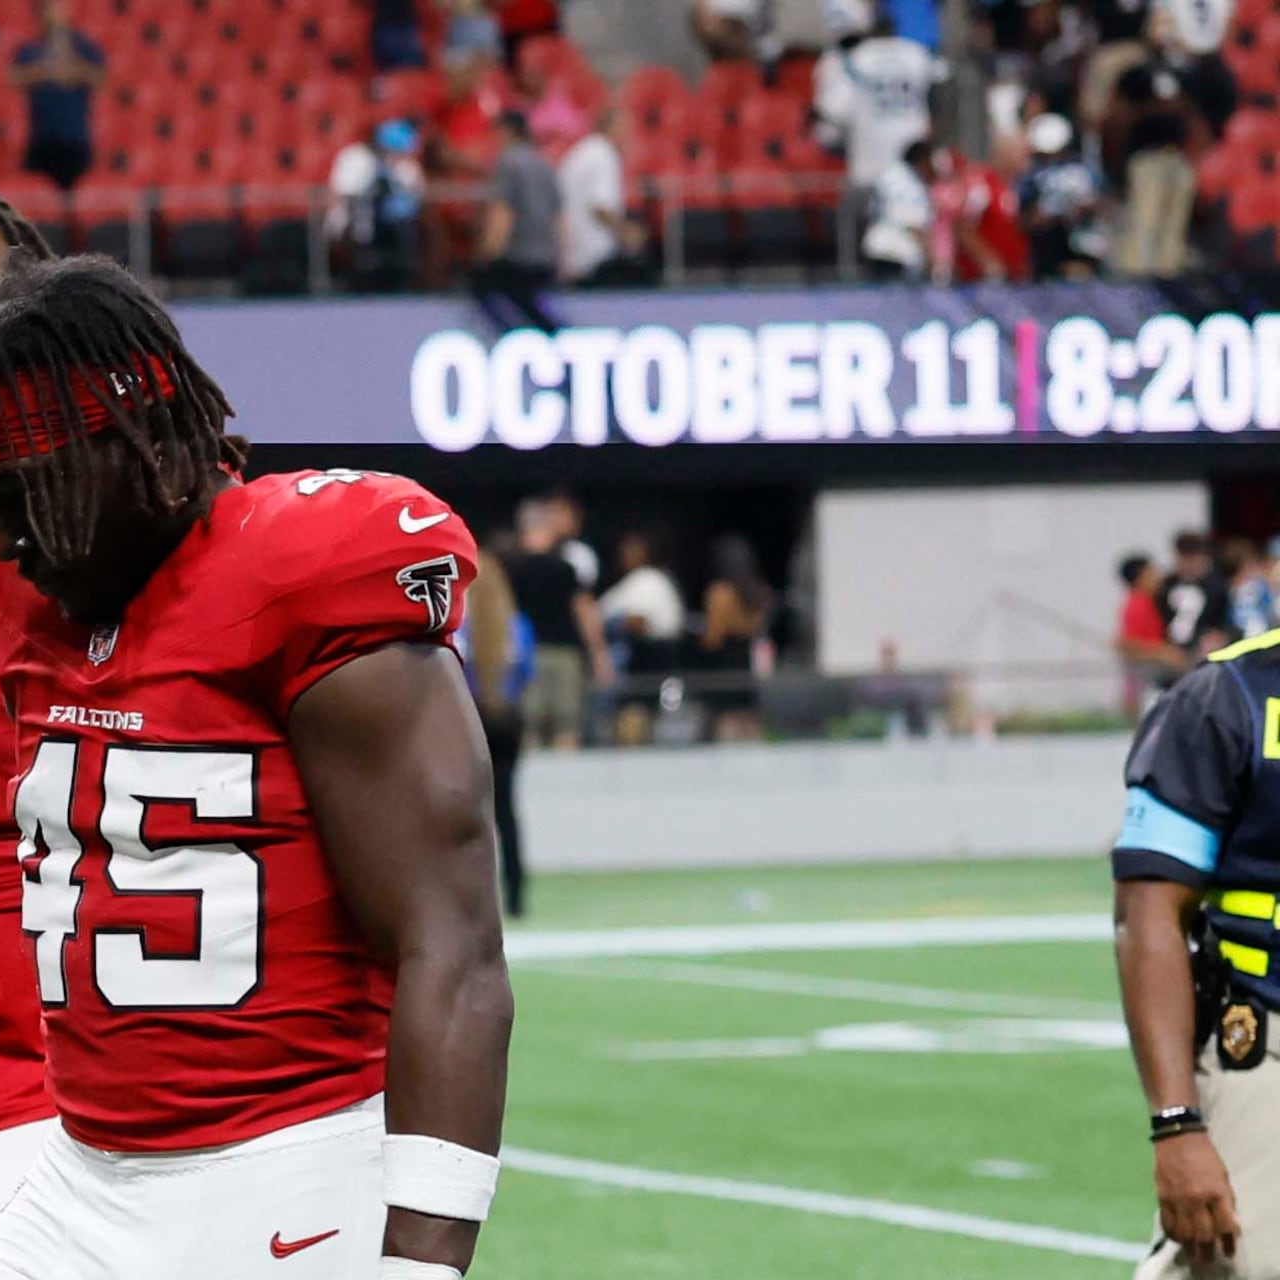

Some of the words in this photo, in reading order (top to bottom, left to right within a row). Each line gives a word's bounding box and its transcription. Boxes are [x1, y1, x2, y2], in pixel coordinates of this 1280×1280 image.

[410, 328, 894, 451] OCTOBER
[902, 316, 1016, 436] 11
[47, 704, 144, 732] FALCONS
[13, 733, 267, 1013] 45
